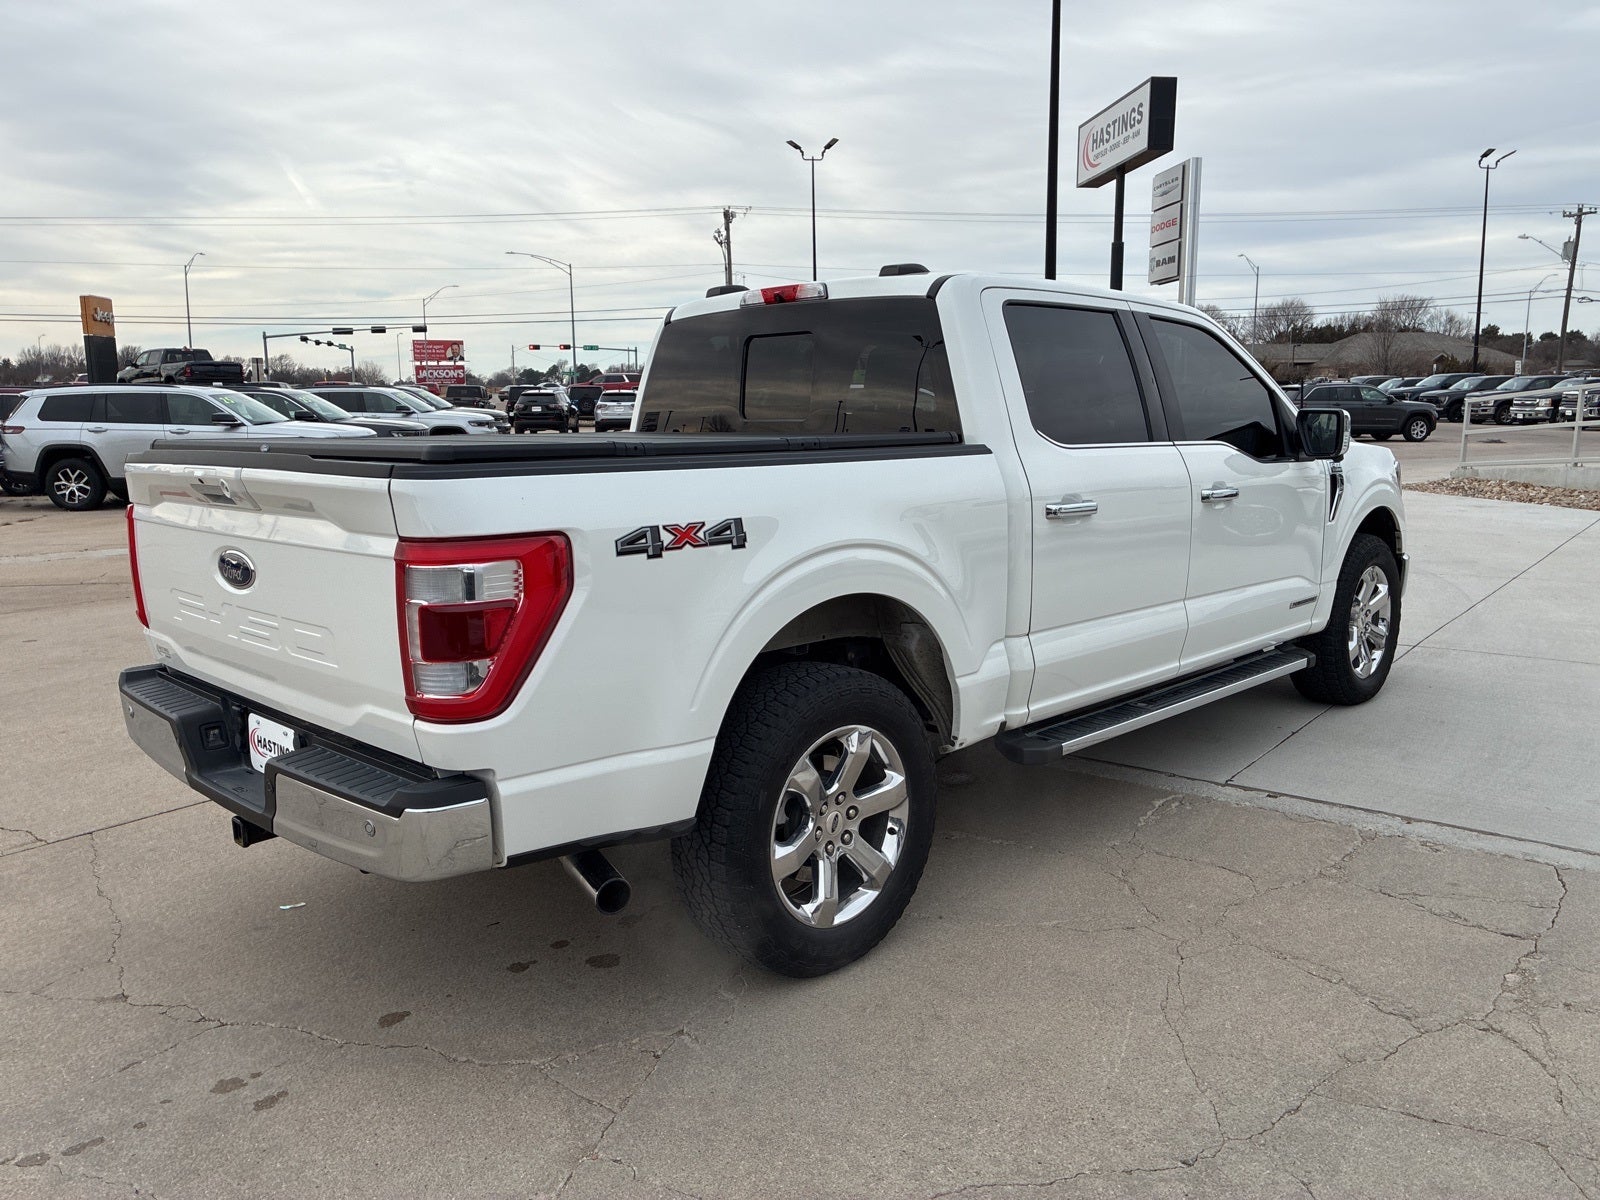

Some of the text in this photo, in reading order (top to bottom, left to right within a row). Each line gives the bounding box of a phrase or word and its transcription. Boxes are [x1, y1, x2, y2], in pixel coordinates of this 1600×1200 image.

[1091, 102, 1144, 152] HASTINGS
[1153, 176, 1179, 192] CHRYSLER
[1151, 217, 1178, 234] DODGE
[1155, 255, 1176, 267] RAM
[94, 306, 114, 325] Jeep
[417, 369, 464, 378] JACKSON'S
[222, 557, 244, 581] Ford
[256, 734, 296, 757] HASTIN
